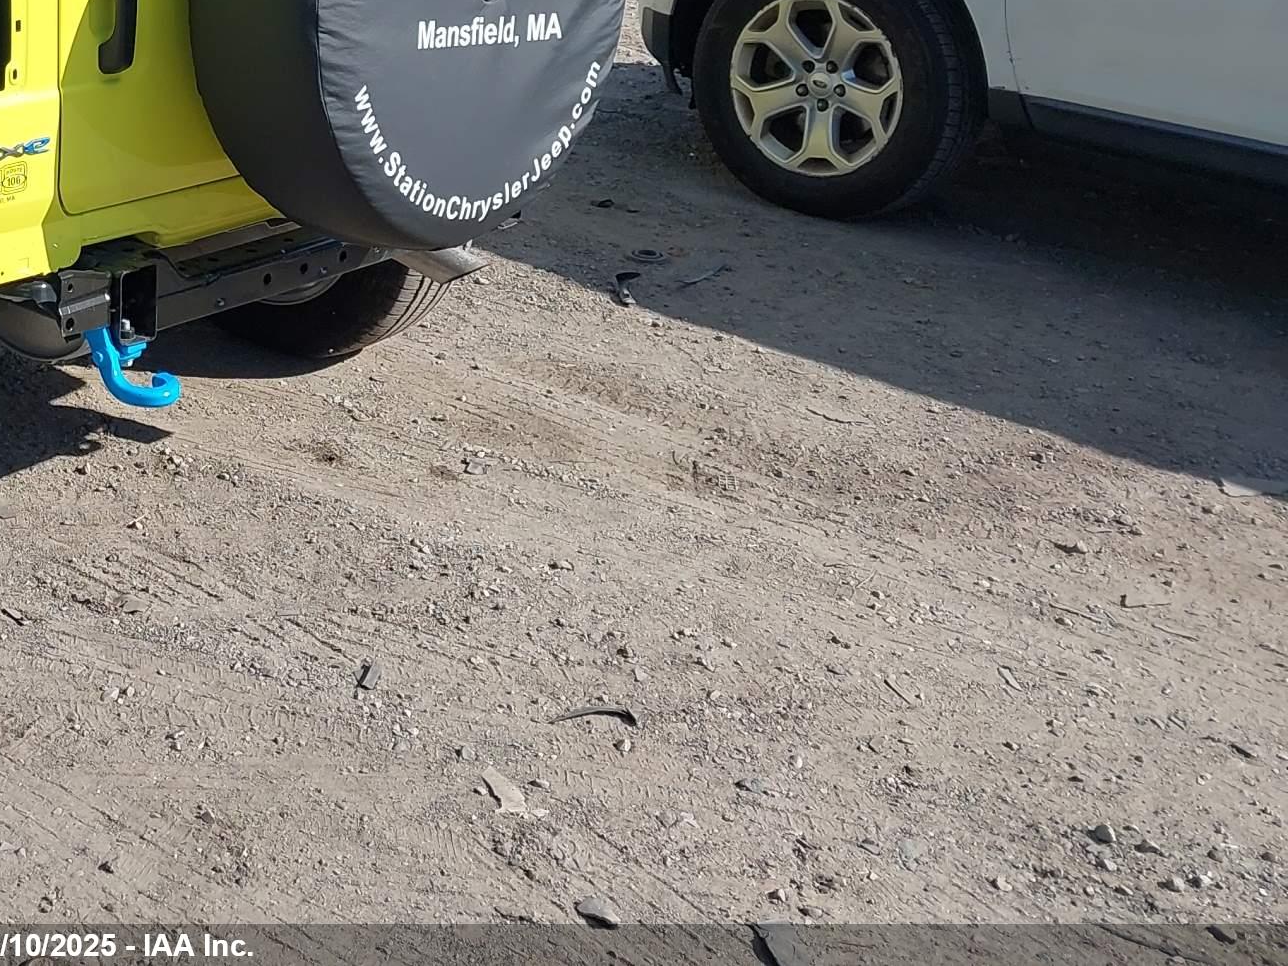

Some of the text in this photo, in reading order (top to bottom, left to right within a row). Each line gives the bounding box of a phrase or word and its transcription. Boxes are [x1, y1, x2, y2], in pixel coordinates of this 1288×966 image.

[417, 12, 563, 51] Mansfield, MA
[353, 61, 602, 224] www.StationChryslerJeep.com
[6, 176, 21, 187] 106
